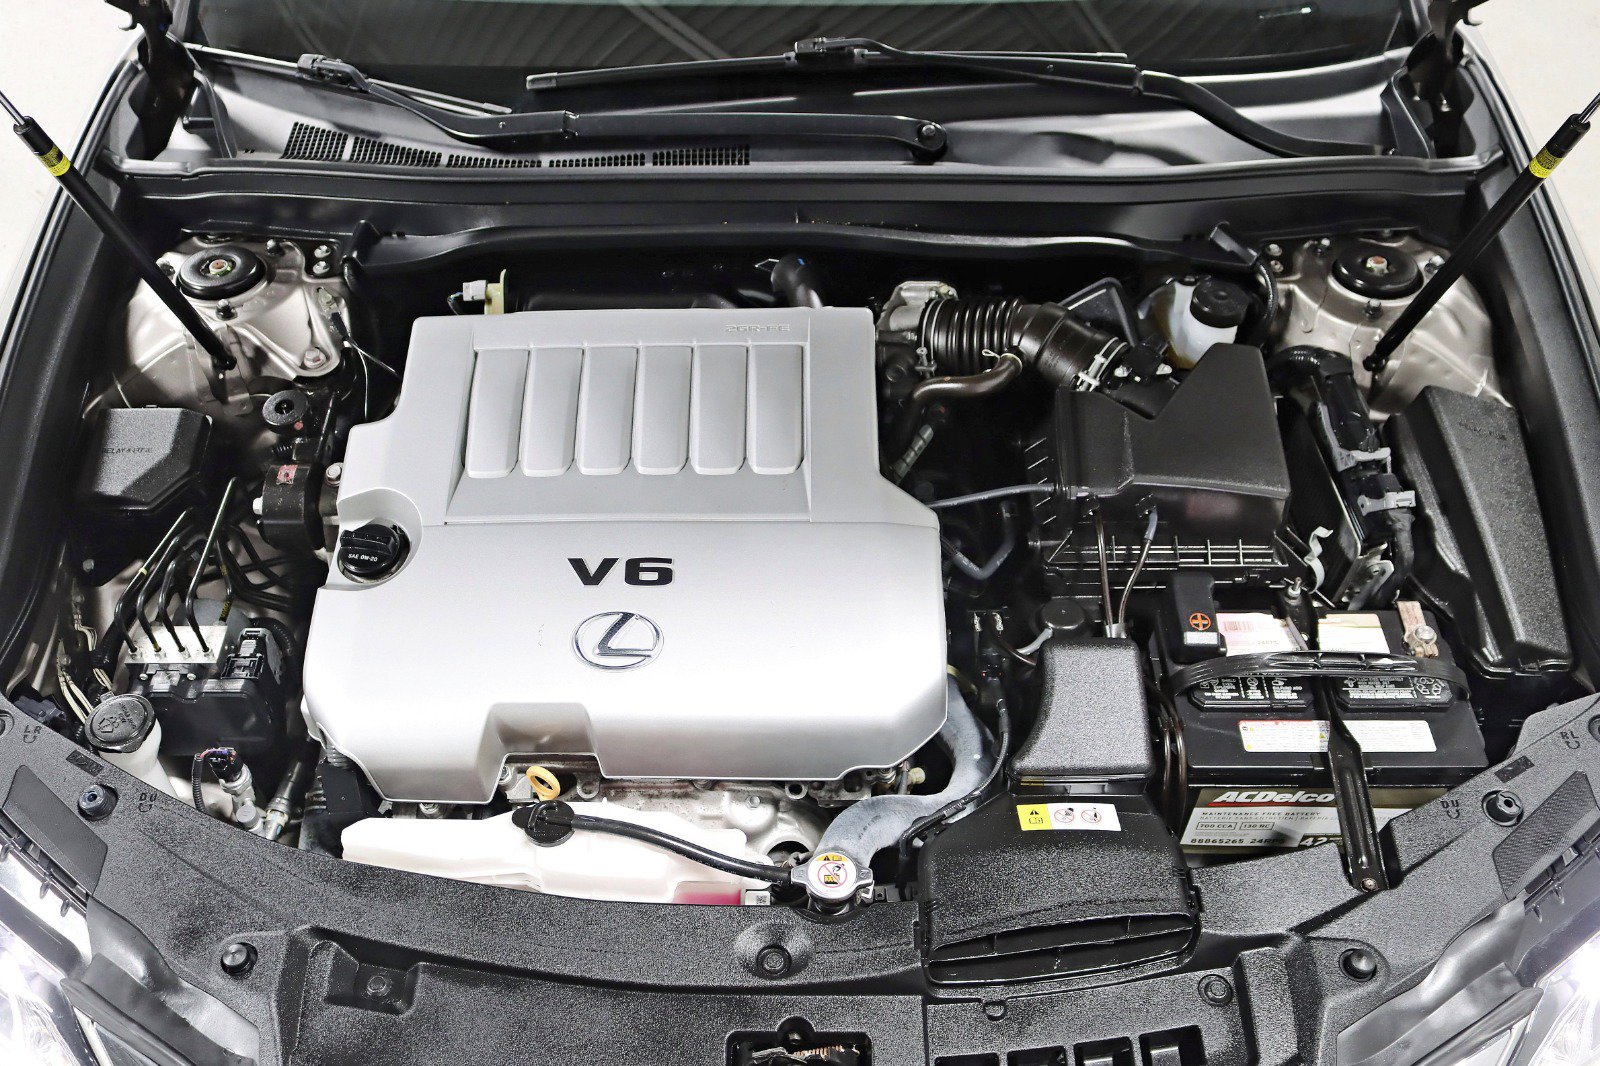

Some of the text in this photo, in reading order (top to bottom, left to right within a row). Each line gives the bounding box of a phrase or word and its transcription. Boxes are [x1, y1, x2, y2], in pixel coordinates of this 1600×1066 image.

[725, 324, 790, 332] 2GR-FE
[567, 557, 673, 586] V6
[1213, 791, 1335, 803] ACDelco
